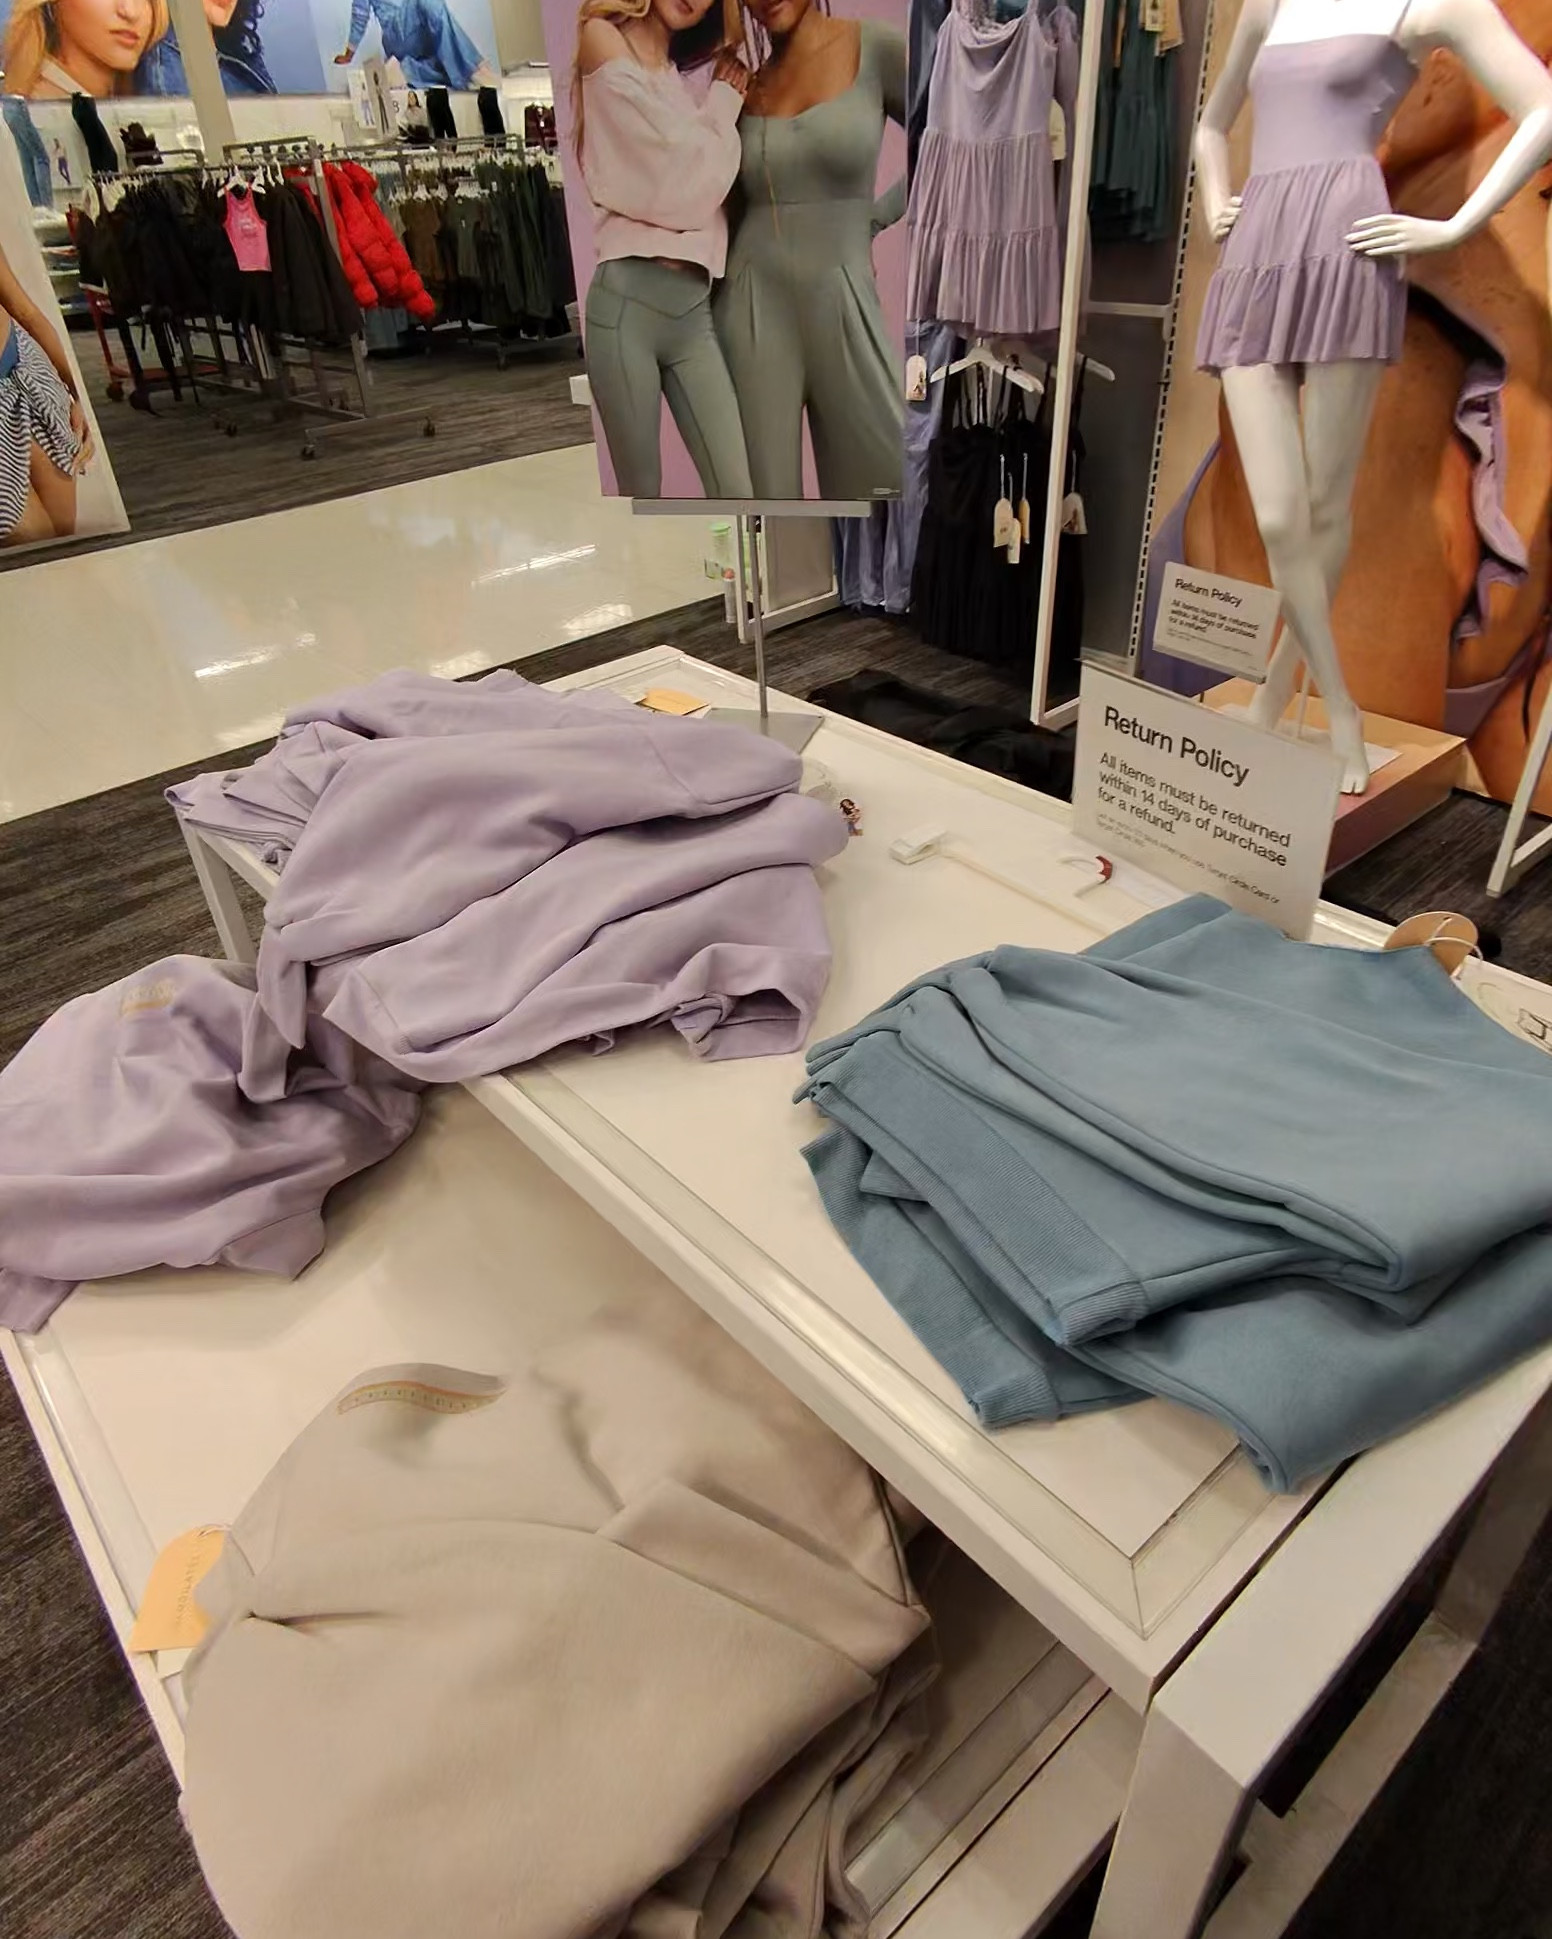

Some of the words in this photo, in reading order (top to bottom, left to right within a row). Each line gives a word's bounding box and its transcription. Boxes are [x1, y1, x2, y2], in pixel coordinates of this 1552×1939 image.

[1175, 578, 1209, 597] Return
[1211, 588, 1243, 608] Policy
[1104, 705, 1173, 753] Return
[1180, 736, 1250, 787] Policy
[1098, 786, 1117, 805] for
[1118, 799, 1127, 812] a
[1099, 771, 1137, 798] within
[1142, 789, 1155, 806] 14
[1158, 799, 1191, 823] days
[1195, 817, 1211, 831] of
[1213, 825, 1287, 867] purchase
[1100, 752, 1117, 769] All
[1120, 759, 1156, 788] items
[1159, 781, 1196, 806] must
[1199, 795, 1218, 815] be
[1222, 809, 1291, 848] returned
